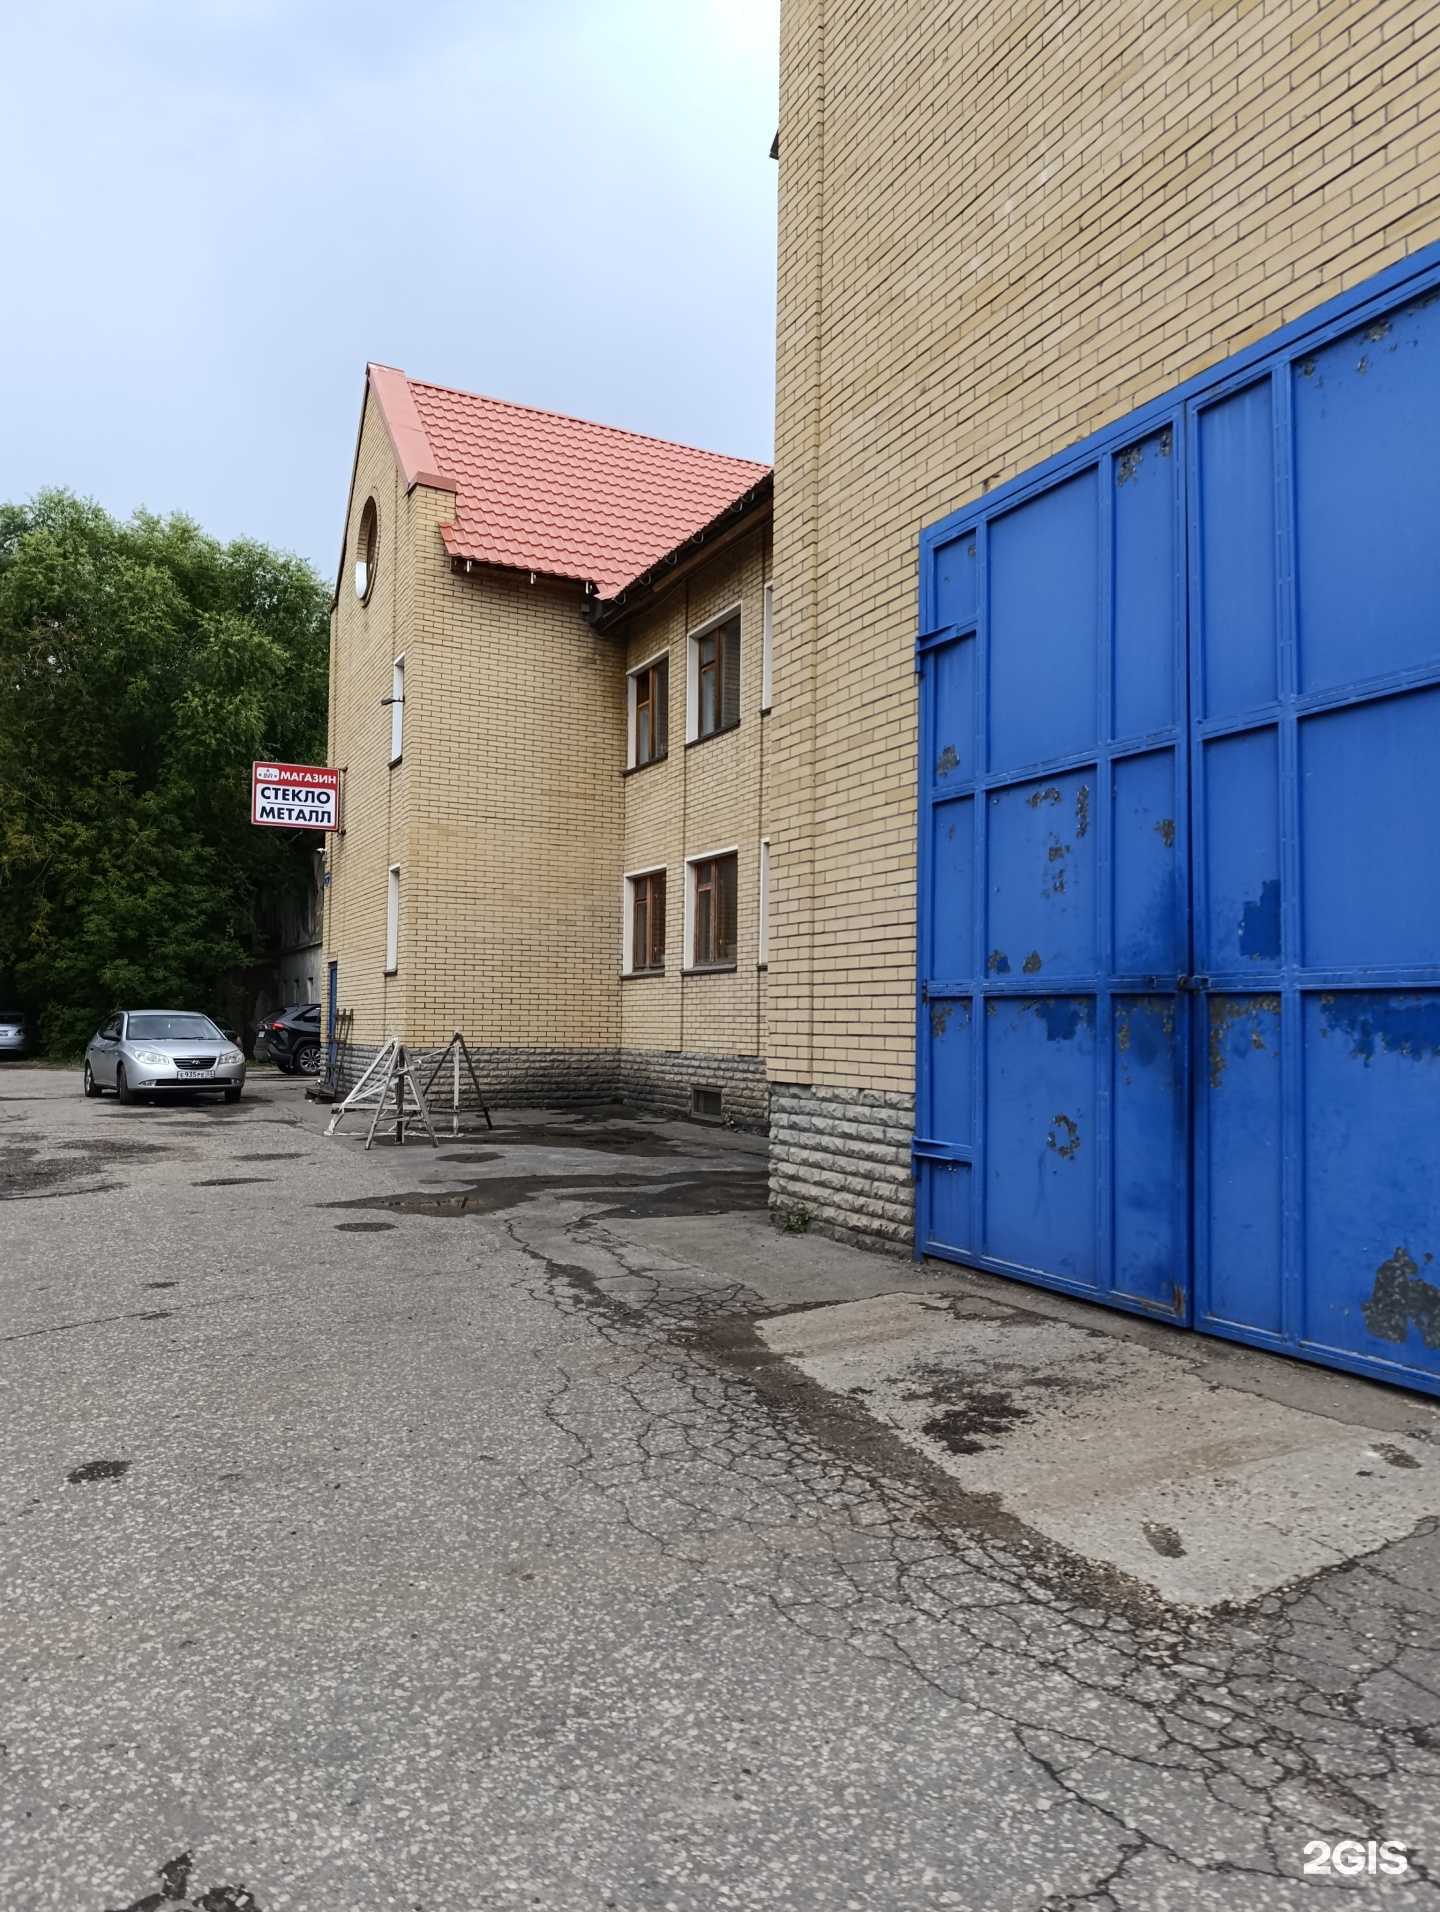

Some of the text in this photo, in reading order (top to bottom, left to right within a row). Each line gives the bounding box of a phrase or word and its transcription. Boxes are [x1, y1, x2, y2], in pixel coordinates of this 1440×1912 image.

[281, 771, 336, 784] МАГАЗИН
[261, 787, 331, 804] СТЕКЛО
[260, 806, 331, 823] МЕТАЛЛ
